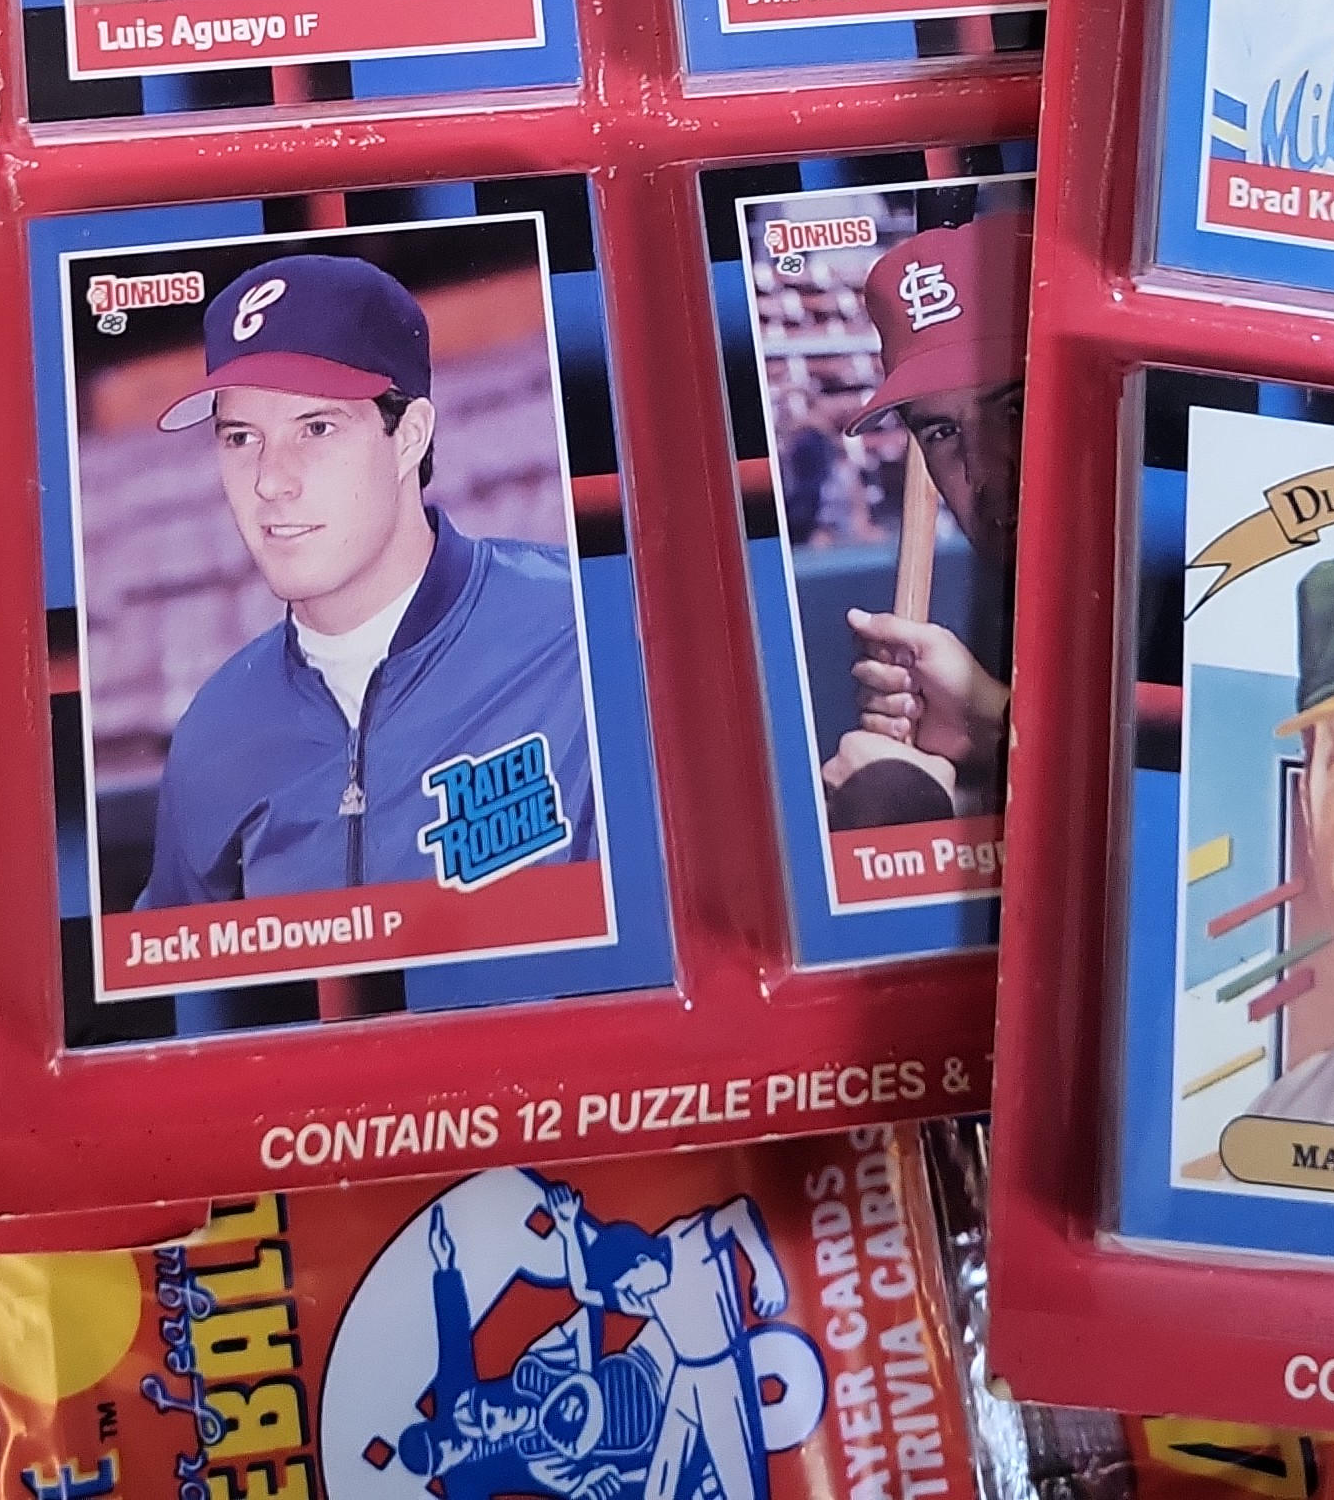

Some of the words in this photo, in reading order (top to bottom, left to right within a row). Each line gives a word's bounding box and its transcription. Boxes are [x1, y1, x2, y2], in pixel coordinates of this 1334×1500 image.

[98, 18, 164, 51] Luis
[171, 14, 286, 52] Aguayo
[293, 13, 319, 38] IF
[1228, 177, 1300, 217] Brad
[768, 220, 872, 254] DONRUSS
[89, 274, 202, 314] DONRUSS
[430, 738, 549, 819] RATED
[425, 788, 567, 883] ROOKIE
[854, 846, 925, 881] Tom
[126, 925, 199, 967] Jack
[209, 906, 373, 954] McDowell
[383, 911, 403, 937] P
[260, 1105, 499, 1170] CONTAINS
[517, 1100, 563, 1142] 12
[577, 1078, 753, 1137] PUZZLE
[765, 1061, 927, 1116] PIECES
[942, 1057, 971, 1092] &
[850, 1122, 916, 1301] CARDS
[806, 1164, 867, 1352] CARDS
[878, 1318, 950, 1500] TRIVIA
